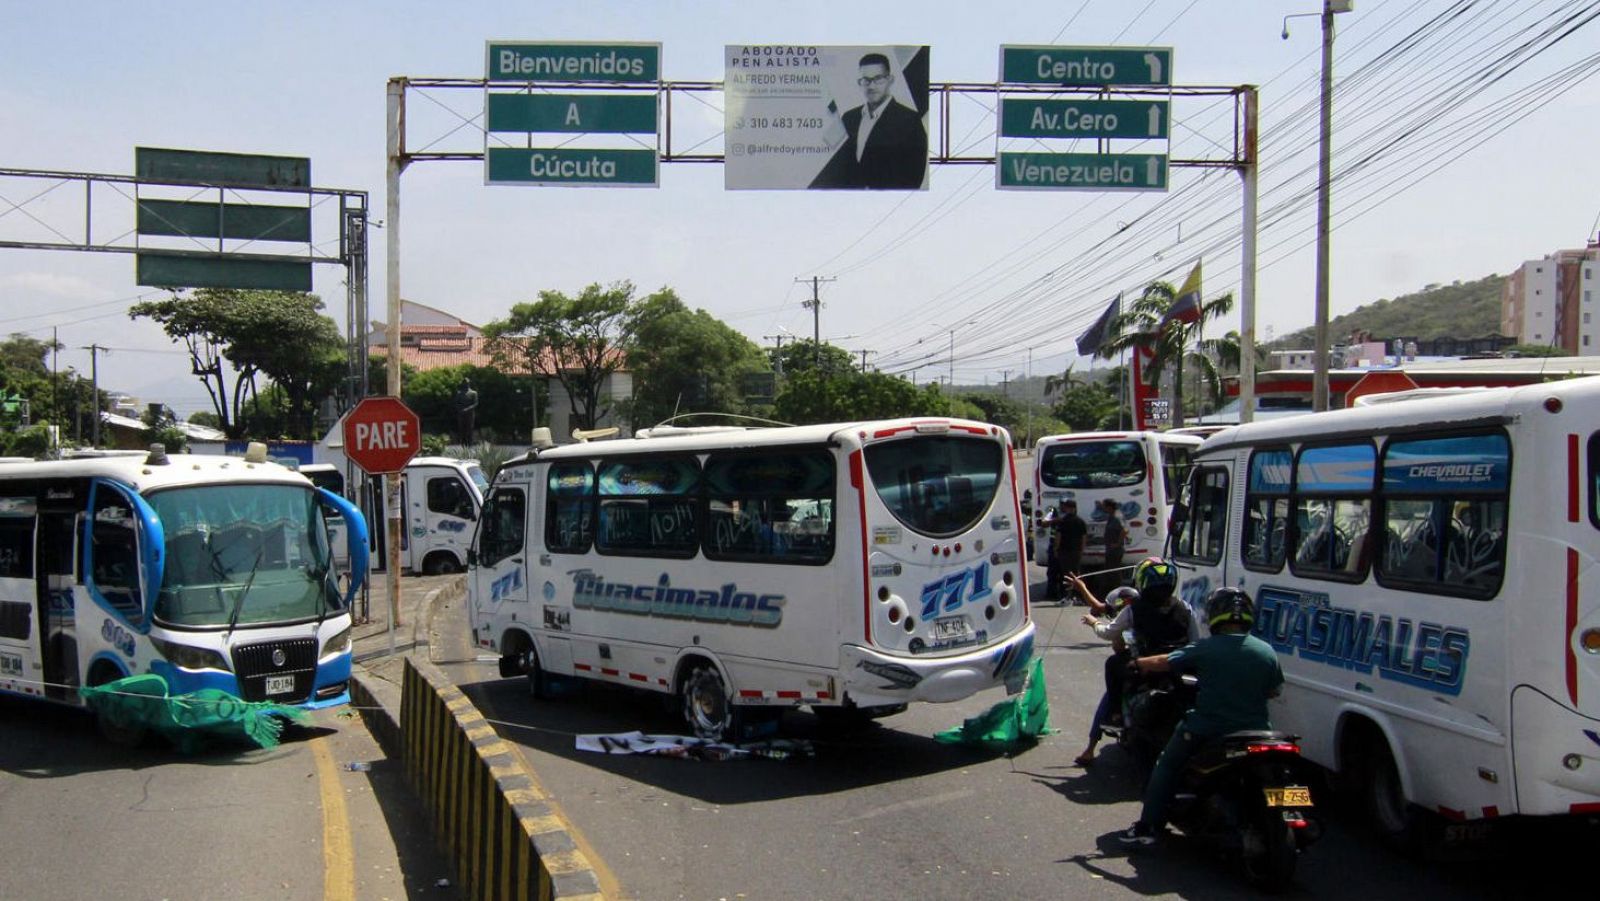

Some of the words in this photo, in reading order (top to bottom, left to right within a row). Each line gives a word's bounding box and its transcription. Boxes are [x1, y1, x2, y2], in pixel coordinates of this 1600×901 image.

[499, 49, 645, 76] Bienvenidos
[742, 46, 818, 56] ABOGADO
[733, 74, 777, 85] ALFREDO
[779, 74, 821, 85] YERMAIN
[1036, 54, 1116, 80] Centro
[564, 102, 582, 127] A
[750, 117, 769, 129] 310
[772, 117, 793, 129] 483
[796, 117, 824, 129] 7403
[529, 152, 617, 178] Cúcuta
[1012, 157, 1135, 184] Venezuela
[355, 420, 410, 452] PARE
[1409, 463, 1495, 478] CHEVROLET
[491, 567, 523, 603] 771
[921, 561, 992, 622] 771
[1252, 585, 1469, 697] GUASIMALES
